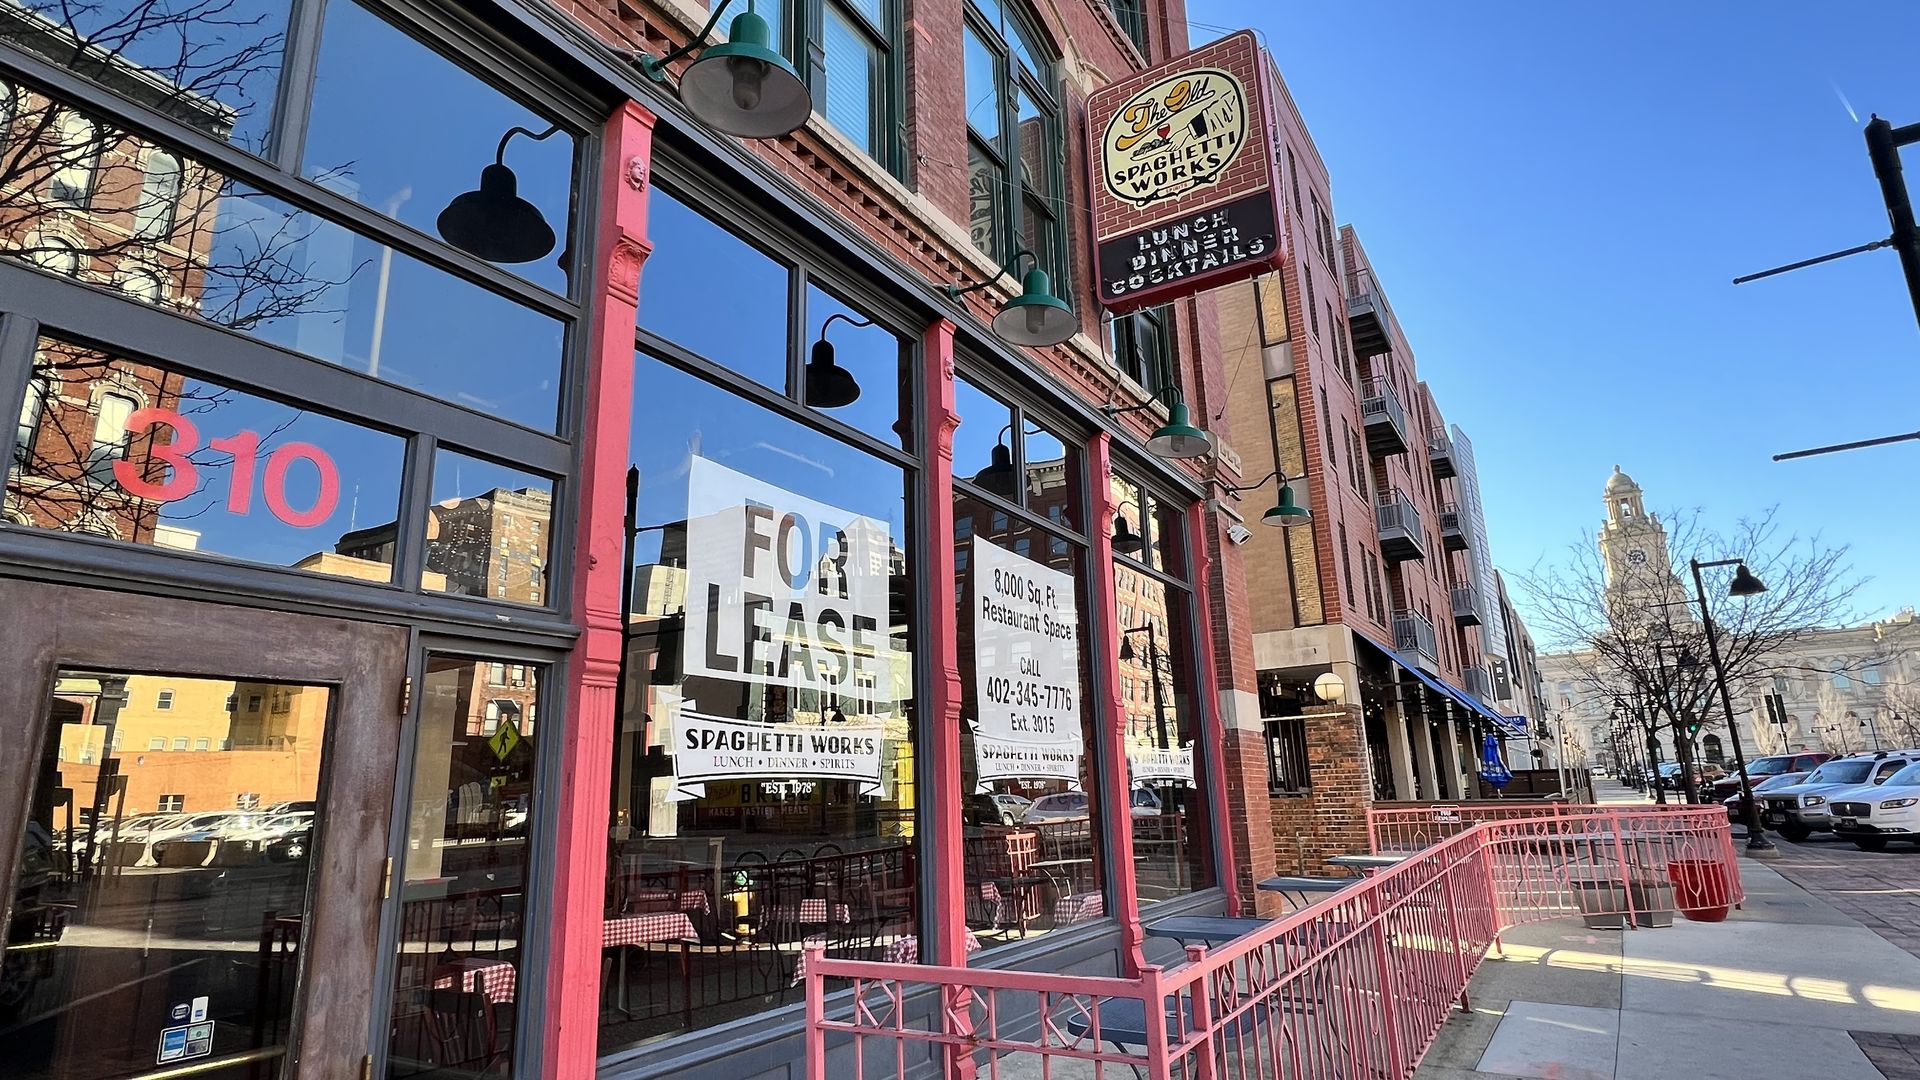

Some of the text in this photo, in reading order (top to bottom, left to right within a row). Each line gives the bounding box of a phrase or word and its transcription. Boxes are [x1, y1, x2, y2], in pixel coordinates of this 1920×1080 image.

[1123, 76, 1216, 134] The Old
[1113, 131, 1236, 186] SPAGHETTI
[1130, 153, 1221, 194] WORKS
[1130, 227, 1240, 271] DINNER
[1138, 208, 1230, 251] LUNCH
[1111, 238, 1266, 295] COCKTAILS
[112, 407, 340, 528] 310
[742, 497, 849, 600] FOR
[994, 568, 1059, 611] 8,000 Sq. Ft.
[705, 583, 877, 688] LEASE
[982, 595, 1072, 643] Restaurant Space
[1019, 656, 1042, 678] CALL
[986, 676, 1072, 712] 402-345-7776
[685, 728, 875, 756] SPAGHETTI WORKS
[1010, 713, 1056, 734] Ext. 3015
[713, 755, 856, 769] LUNCH DINNER SPIRITS
[982, 744, 1074, 762] SPAGHETTI WORKS
